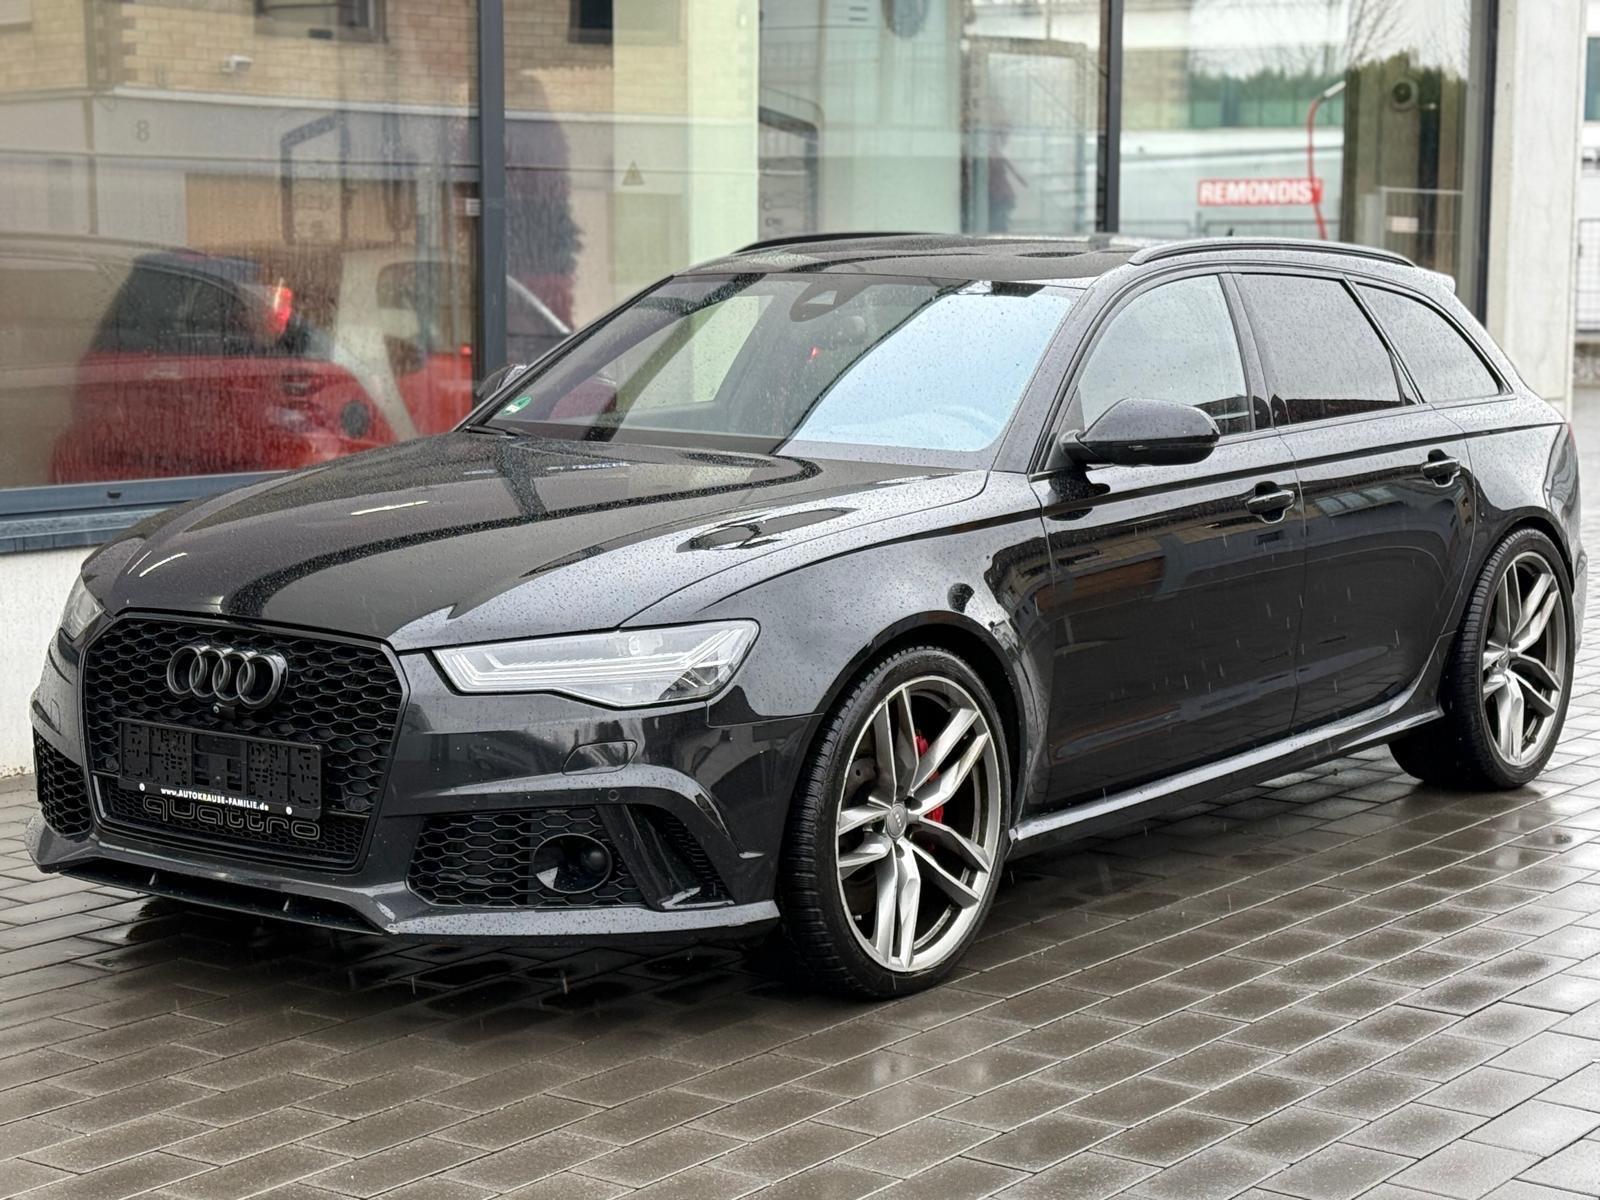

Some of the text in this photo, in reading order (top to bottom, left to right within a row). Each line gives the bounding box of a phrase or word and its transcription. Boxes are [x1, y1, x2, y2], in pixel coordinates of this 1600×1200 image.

[135, 119, 150, 142] 8
[1199, 179, 1313, 204] REMONDIS
[160, 787, 269, 811] www.AUTOKRAUSE-FAMILIE.de
[143, 795, 320, 840] quattro
